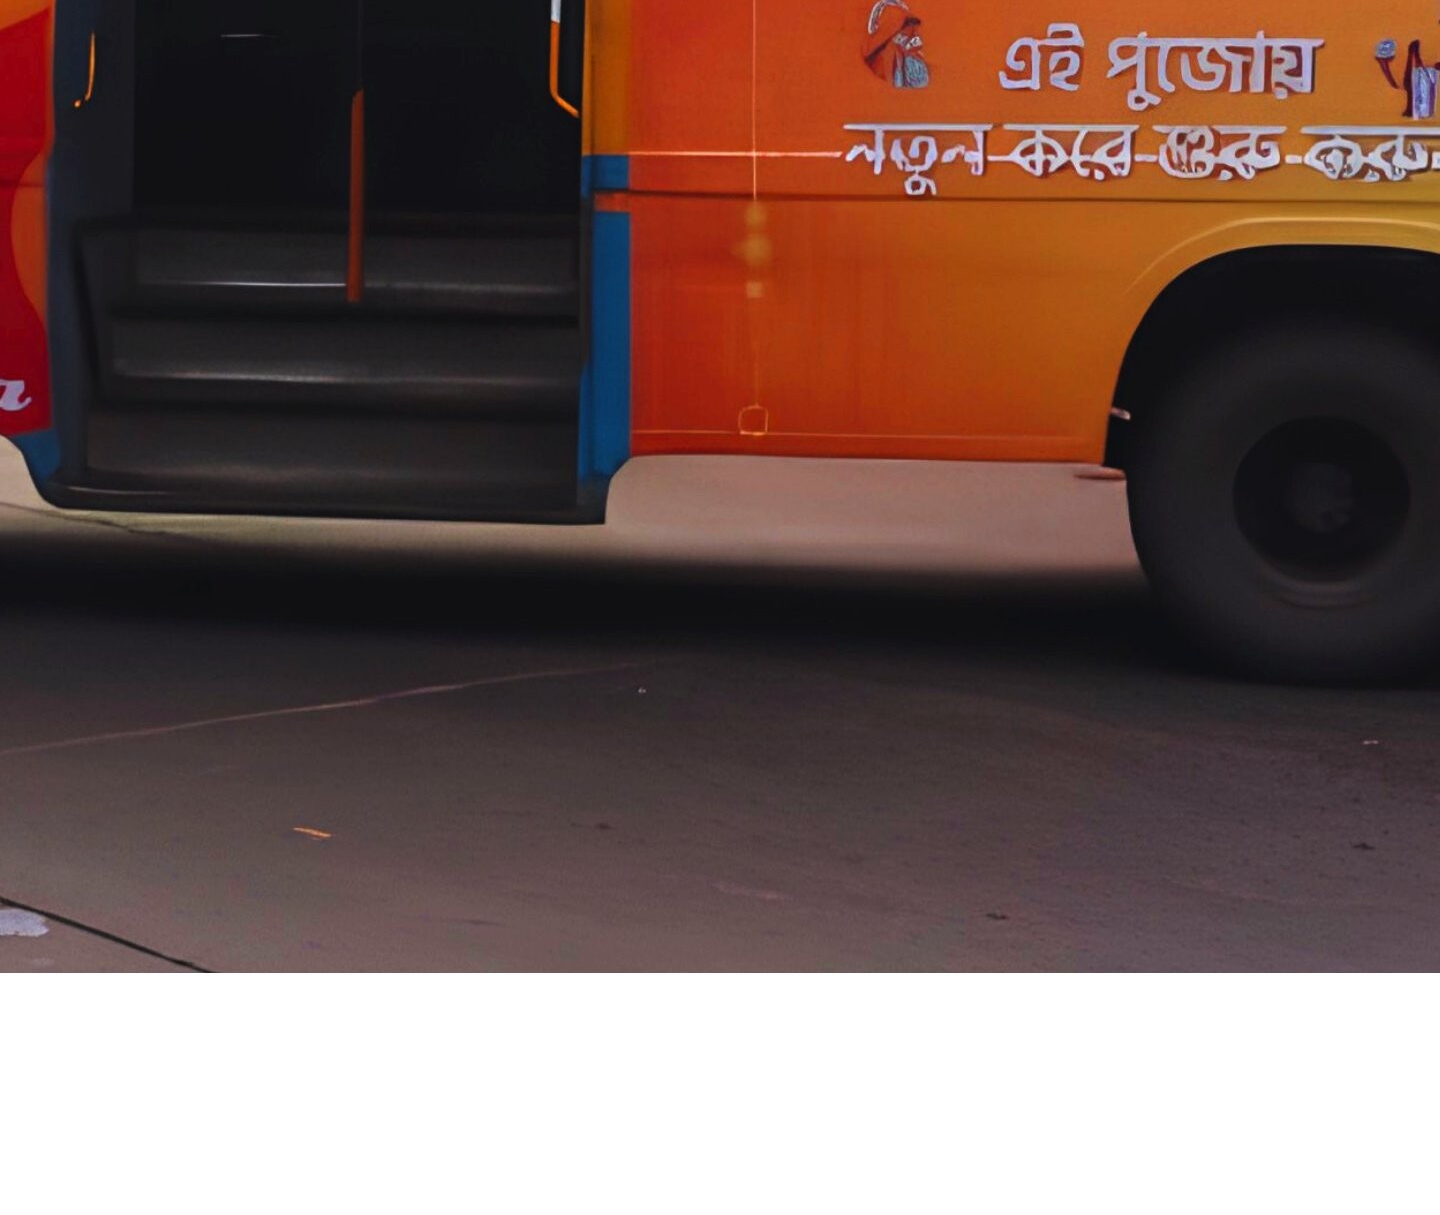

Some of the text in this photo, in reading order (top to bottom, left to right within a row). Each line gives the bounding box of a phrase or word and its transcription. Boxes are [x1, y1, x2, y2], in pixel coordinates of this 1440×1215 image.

[999, 23, 1324, 111] এই পুজোয়
[844, 123, 992, 195] নতুন
[1003, 124, 1139, 180] করে
